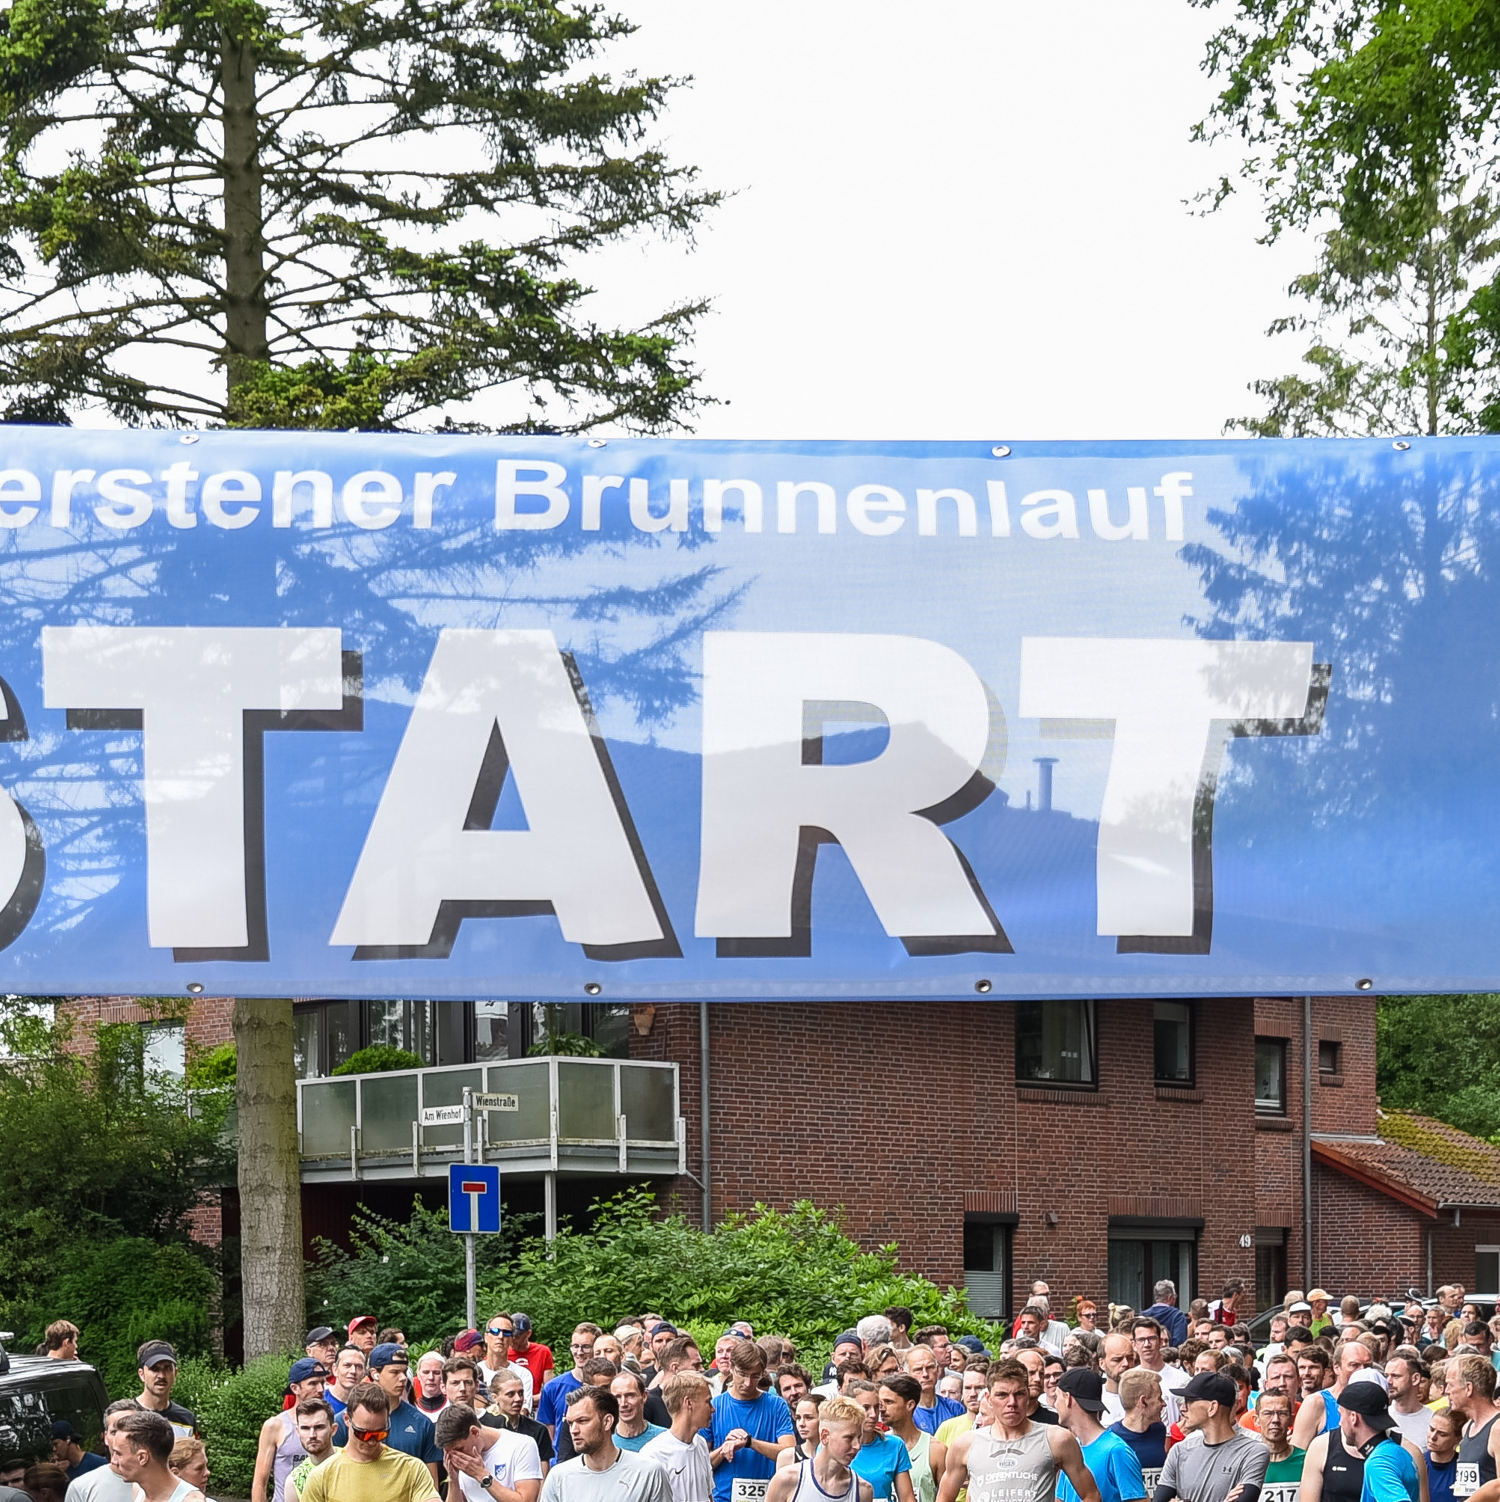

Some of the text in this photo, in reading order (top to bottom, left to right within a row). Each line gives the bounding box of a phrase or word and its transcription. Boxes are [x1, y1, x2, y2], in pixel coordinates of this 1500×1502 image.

[494, 458, 1198, 543] Brunnenlauf
[475, 1095, 516, 1107] Wienstraße
[424, 1108, 462, 1121] Am Wienhof
[738, 1484, 766, 1497] 325
[991, 1488, 1038, 1498] LEIFERT
